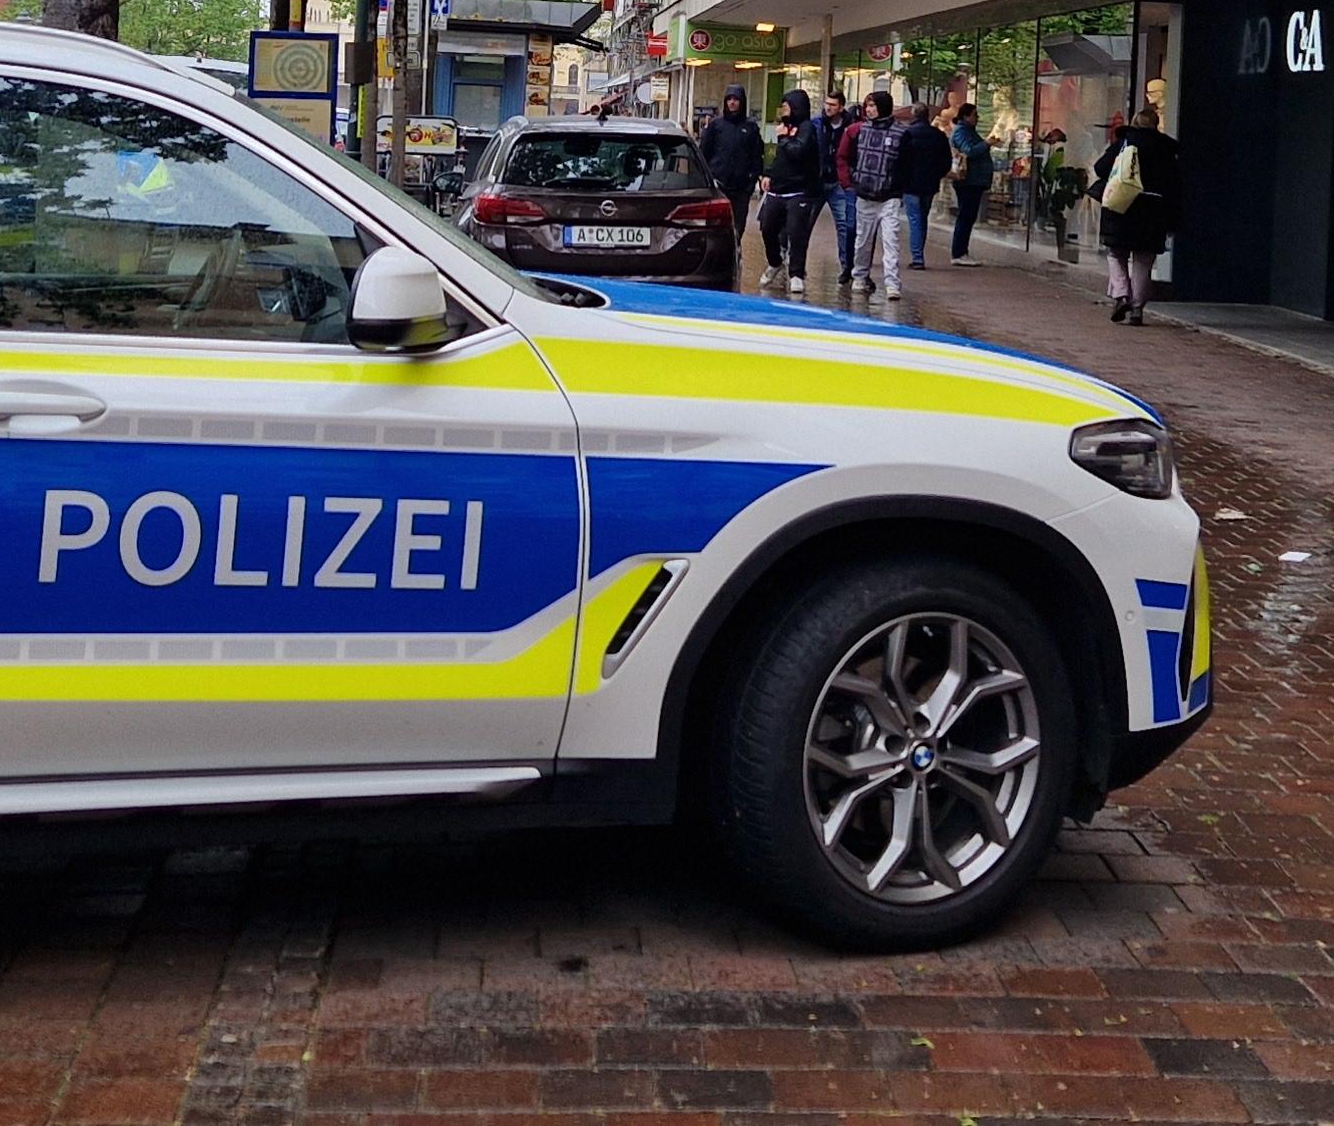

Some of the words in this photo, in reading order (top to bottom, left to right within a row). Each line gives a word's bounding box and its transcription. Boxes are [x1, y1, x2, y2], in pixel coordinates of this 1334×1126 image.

[714, 34, 737, 51] go
[741, 34, 776, 49] asia
[1286, 9, 1326, 73] C&A
[577, 228, 587, 242] A
[596, 228, 615, 243] CX
[617, 229, 644, 243] 106
[38, 489, 484, 591] POLIZEI
